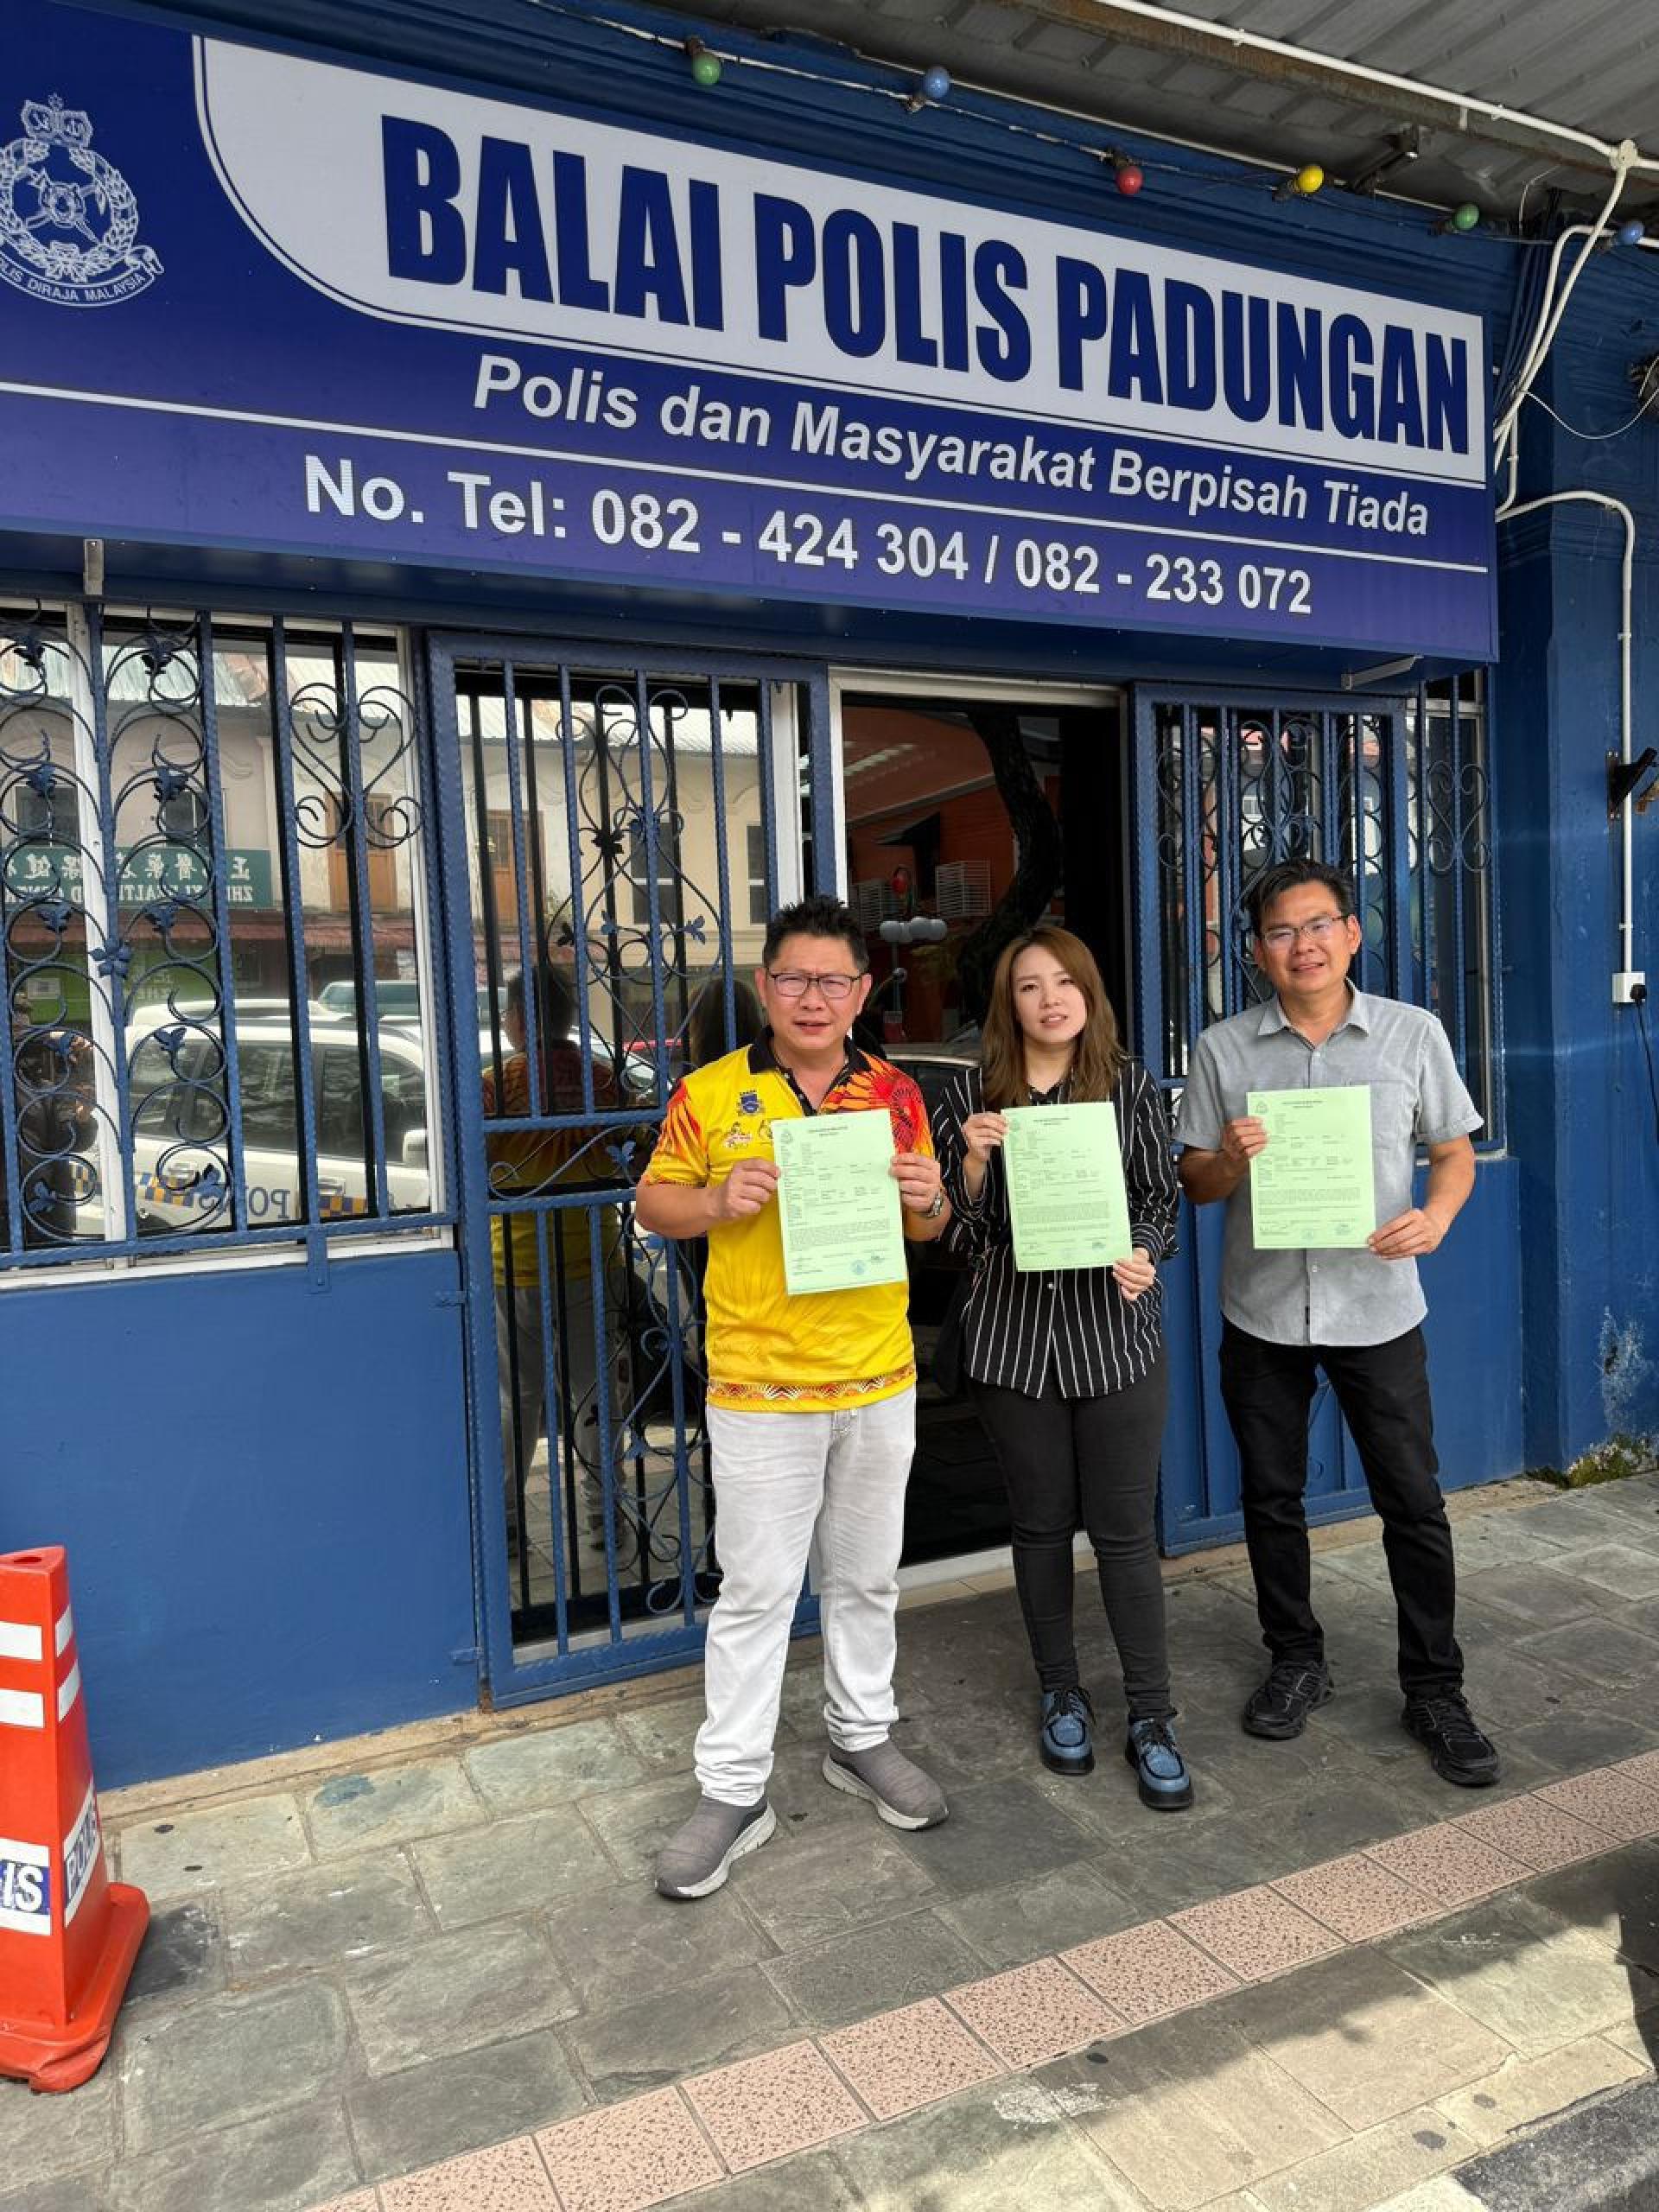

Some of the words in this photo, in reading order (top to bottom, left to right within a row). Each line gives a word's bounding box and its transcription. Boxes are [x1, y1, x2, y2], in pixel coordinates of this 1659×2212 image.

[28, 277, 79, 302] DIRAJA
[84, 273, 145, 302] MALAYSIA
[382, 114, 724, 332] BALAI
[753, 192, 1032, 382] POLIS
[1056, 256, 1469, 454] PADUNGAN
[475, 354, 638, 427] Polis
[662, 385, 769, 446] dan
[791, 403, 1095, 491] Masyarakat
[1109, 449, 1306, 518] Berpisah
[1325, 480, 1428, 535] Tiada
[306, 456, 423, 523] No.
[448, 472, 565, 537] Tel:
[593, 489, 700, 553] 082
[722, 532, 741, 543] -
[759, 512, 857, 569] 424
[878, 524, 968, 579] 304
[985, 536, 999, 583] /
[1016, 539, 1099, 593] 082
[1118, 574, 1132, 584] -
[1147, 555, 1224, 605] 233
[1239, 565, 1310, 613] 072
[0, 1862, 43, 1911] IS
